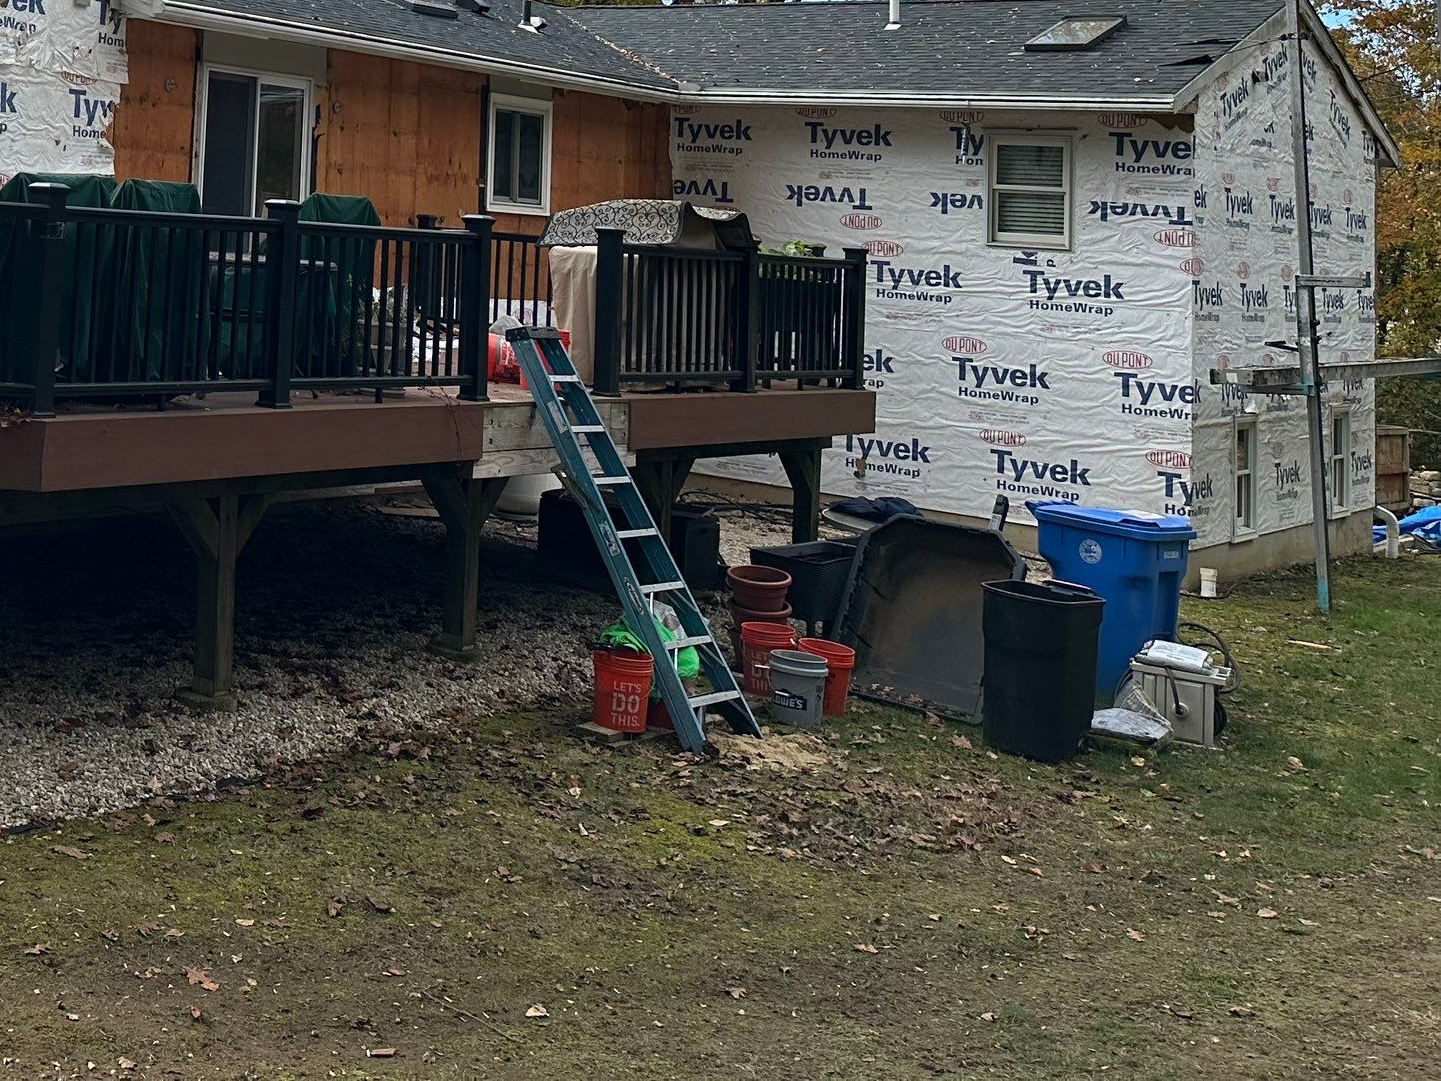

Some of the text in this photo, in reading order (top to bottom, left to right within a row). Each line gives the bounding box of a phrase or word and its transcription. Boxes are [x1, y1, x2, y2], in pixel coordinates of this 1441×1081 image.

[1262, 42, 1288, 76] Tyvek
[69, 88, 115, 126] Tyv
[1220, 77, 1249, 117] Tyvek
[73, 125, 106, 139] Home
[674, 117, 753, 143] Tyvek
[805, 121, 893, 150] Tyvek
[677, 143, 743, 156] HomeWrap
[810, 149, 882, 163] HomeWrap
[1109, 131, 1196, 164] Tyve
[1115, 162, 1196, 178] HomeWra
[673, 179, 734, 203] Tyve
[786, 183, 873, 211] Tyvek
[930, 191, 983, 214] vek
[1224, 187, 1253, 218] Tyvek
[1269, 194, 1295, 223] Tyvek
[1310, 201, 1332, 228] Tyvek
[1345, 207, 1367, 232] Tyvek
[870, 260, 963, 290] Tyvek
[1022, 269, 1125, 301] Tyvek
[876, 288, 953, 305] HomeWrap
[1029, 300, 1114, 316] HomeWrap
[1192, 280, 1223, 311] Tyvek
[1240, 283, 1268, 312] Tyvek
[1322, 288, 1344, 314] Tyvek
[952, 357, 1050, 390] Tyvek
[958, 387, 1039, 405] HomeWrap
[1114, 372, 1202, 406] Tyvek
[845, 434, 931, 463] Tyvek
[845, 457, 920, 478] HmeWrap
[990, 449, 1092, 486] Tyvek
[1275, 460, 1300, 487] Tyvek
[1350, 450, 1372, 476] Tyvek
[996, 479, 1080, 502] HomeWrap
[1157, 471, 1213, 507] Tyvek
[613, 680, 642, 693] LET'S
[612, 691, 640, 714] DO
[610, 712, 640, 727] THIS.
